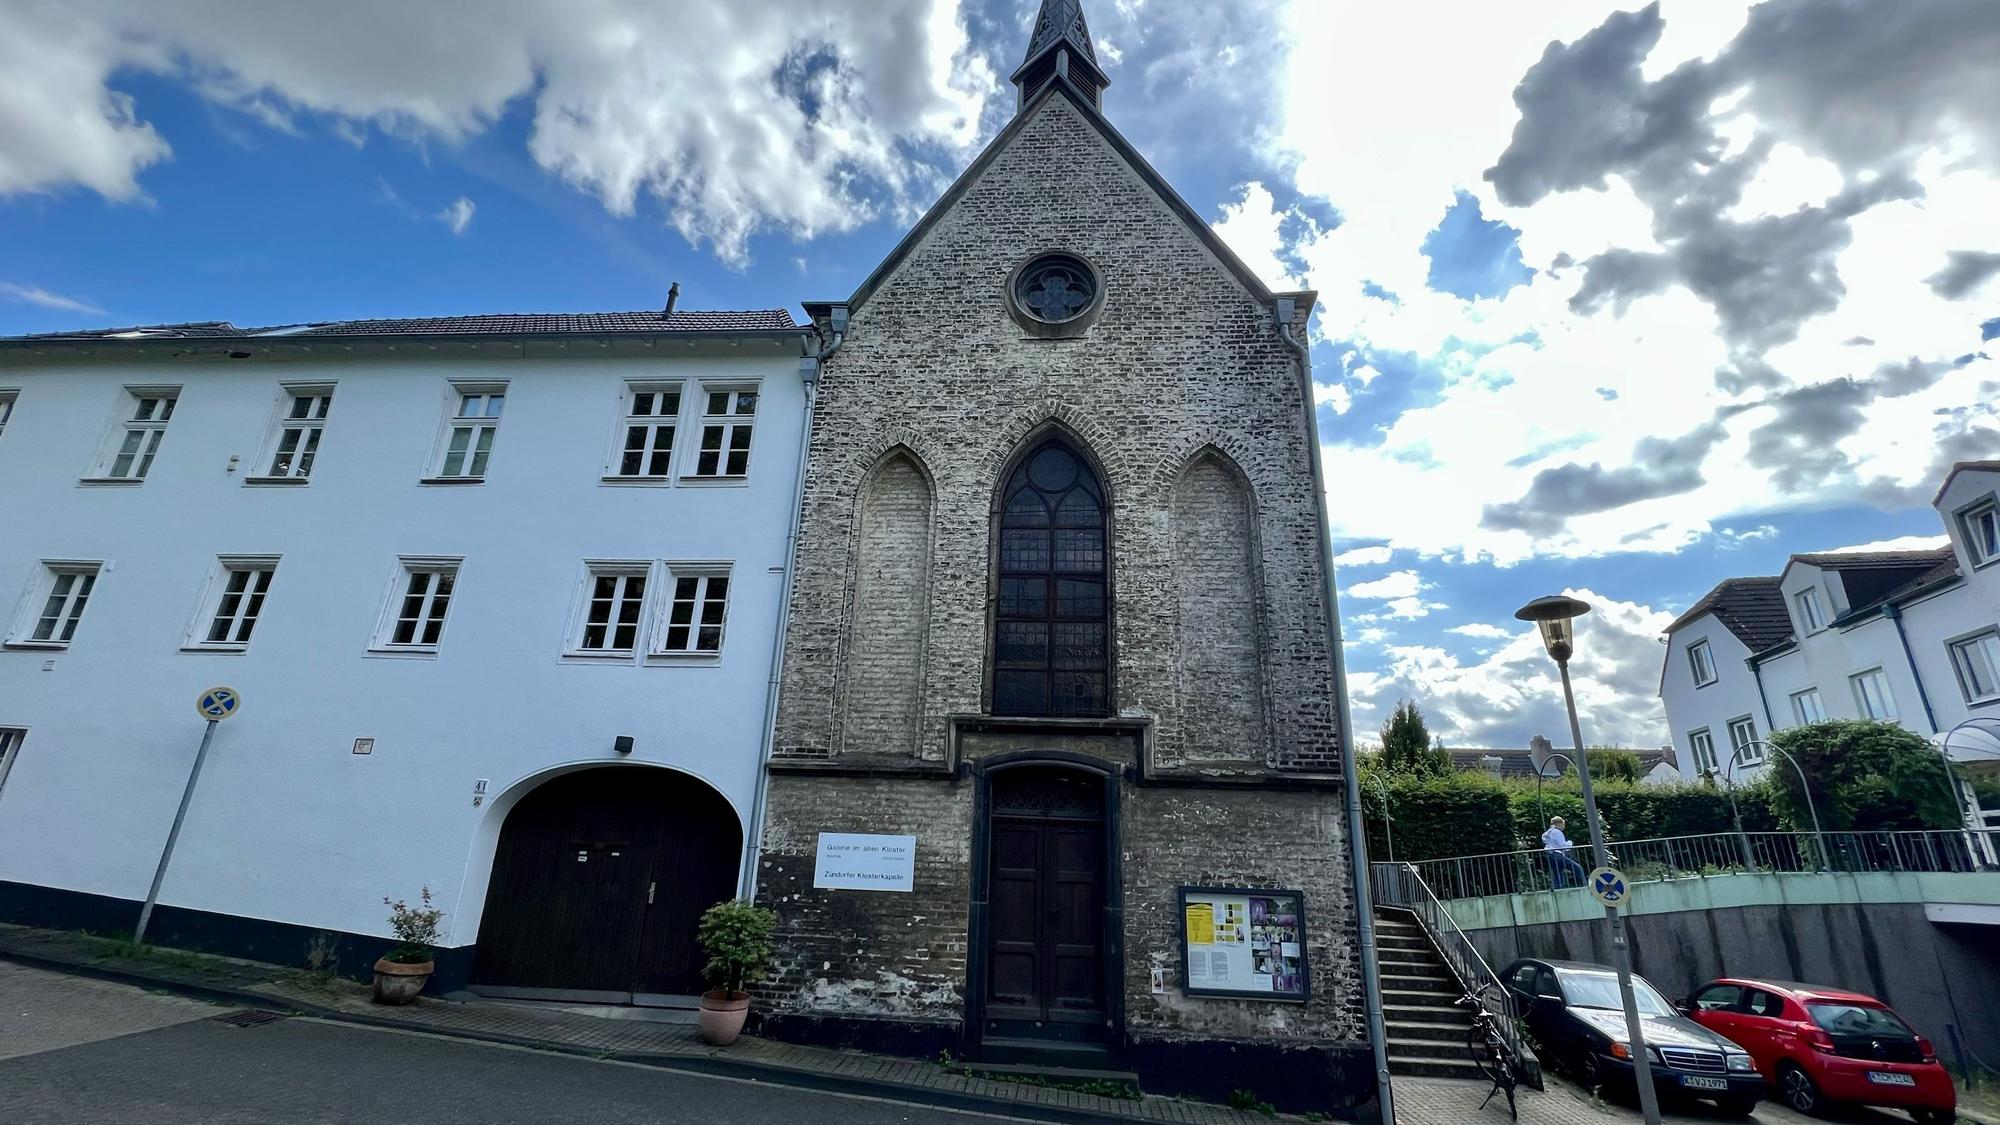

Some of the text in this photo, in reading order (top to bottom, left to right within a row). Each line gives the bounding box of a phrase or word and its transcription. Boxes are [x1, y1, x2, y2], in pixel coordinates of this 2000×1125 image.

[475, 782, 486, 791] 41
[824, 870, 904, 881] Zündorfer Klosterkapelle
